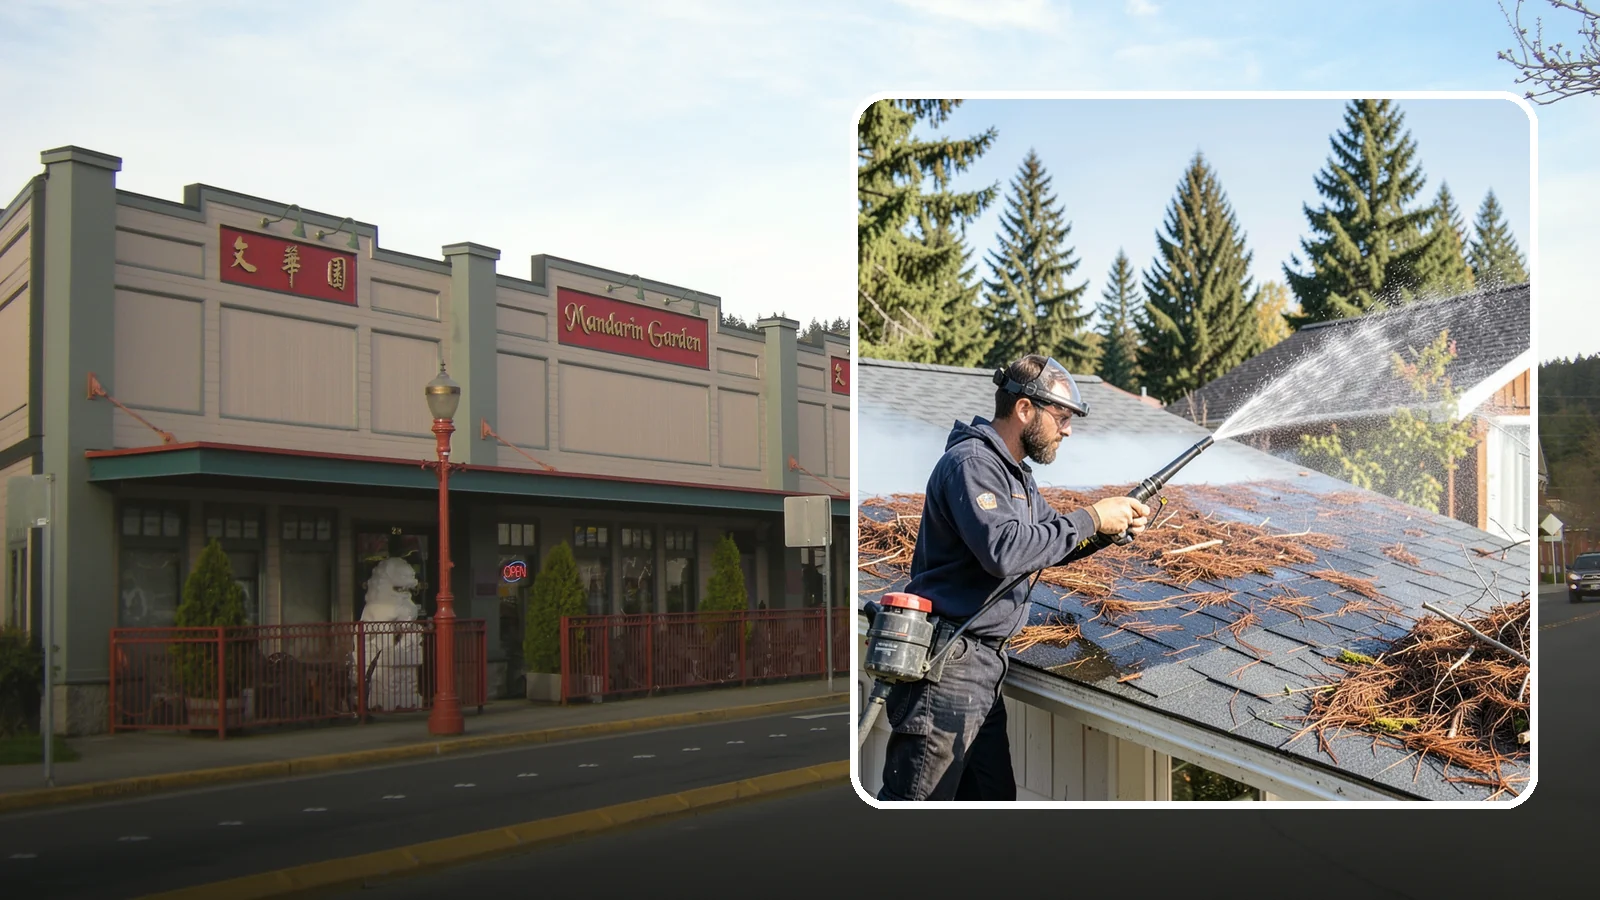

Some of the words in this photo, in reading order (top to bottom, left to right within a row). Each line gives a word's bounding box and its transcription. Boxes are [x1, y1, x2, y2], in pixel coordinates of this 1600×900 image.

[231, 235, 346, 290] 文華園
[564, 302, 644, 340] Mandarin
[648, 320, 701, 352] Garden
[503, 565, 527, 578] OPEN
